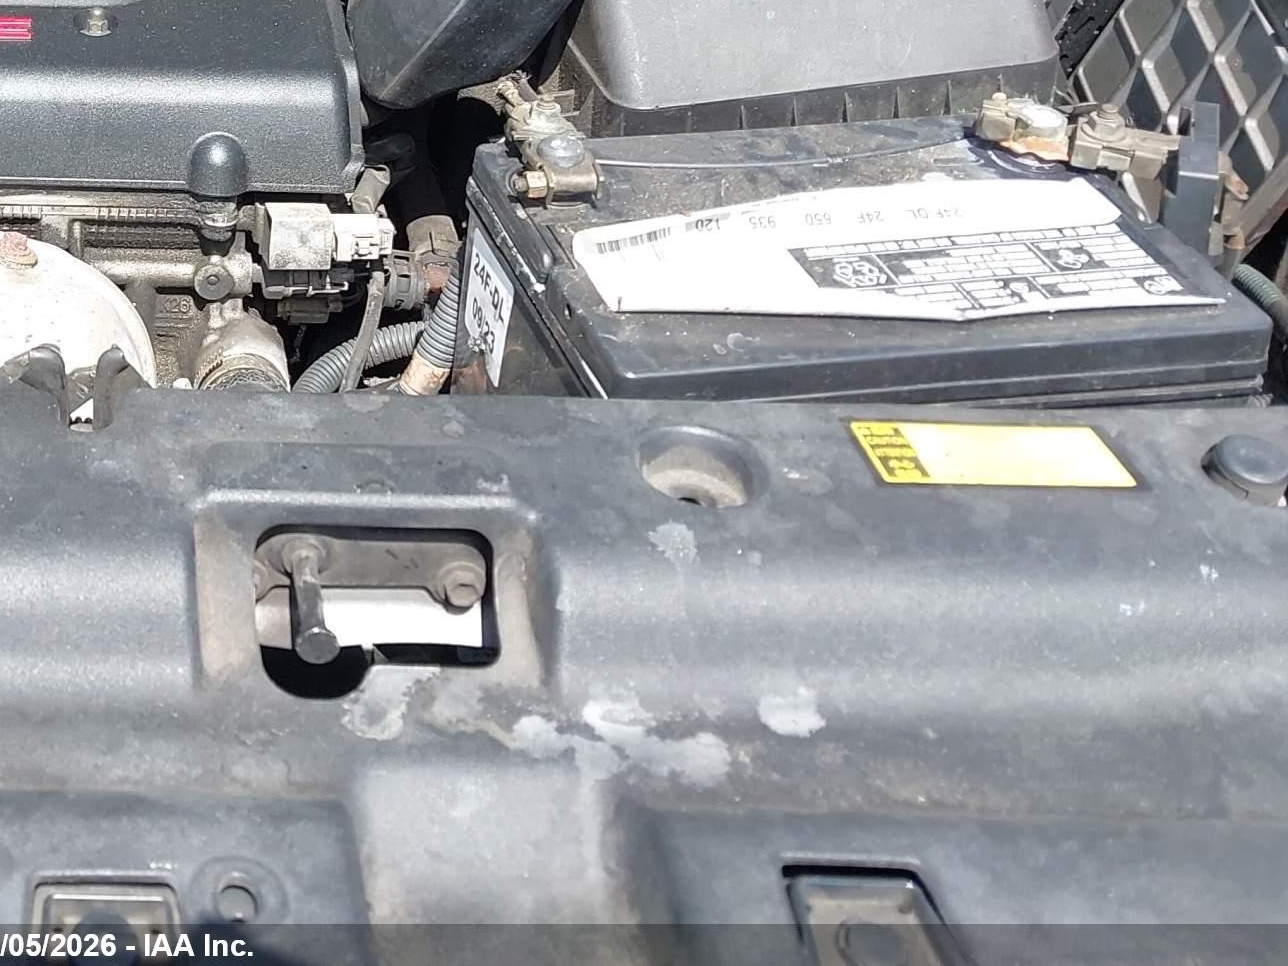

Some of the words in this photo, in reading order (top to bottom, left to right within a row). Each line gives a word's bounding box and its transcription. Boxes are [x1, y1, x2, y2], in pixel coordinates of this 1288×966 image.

[748, 215, 777, 229] 935
[804, 212, 833, 226] 650
[857, 210, 885, 224] 24F
[695, 217, 721, 232] 120
[473, 252, 505, 325] 24F-DL
[472, 297, 496, 355] 09/23
